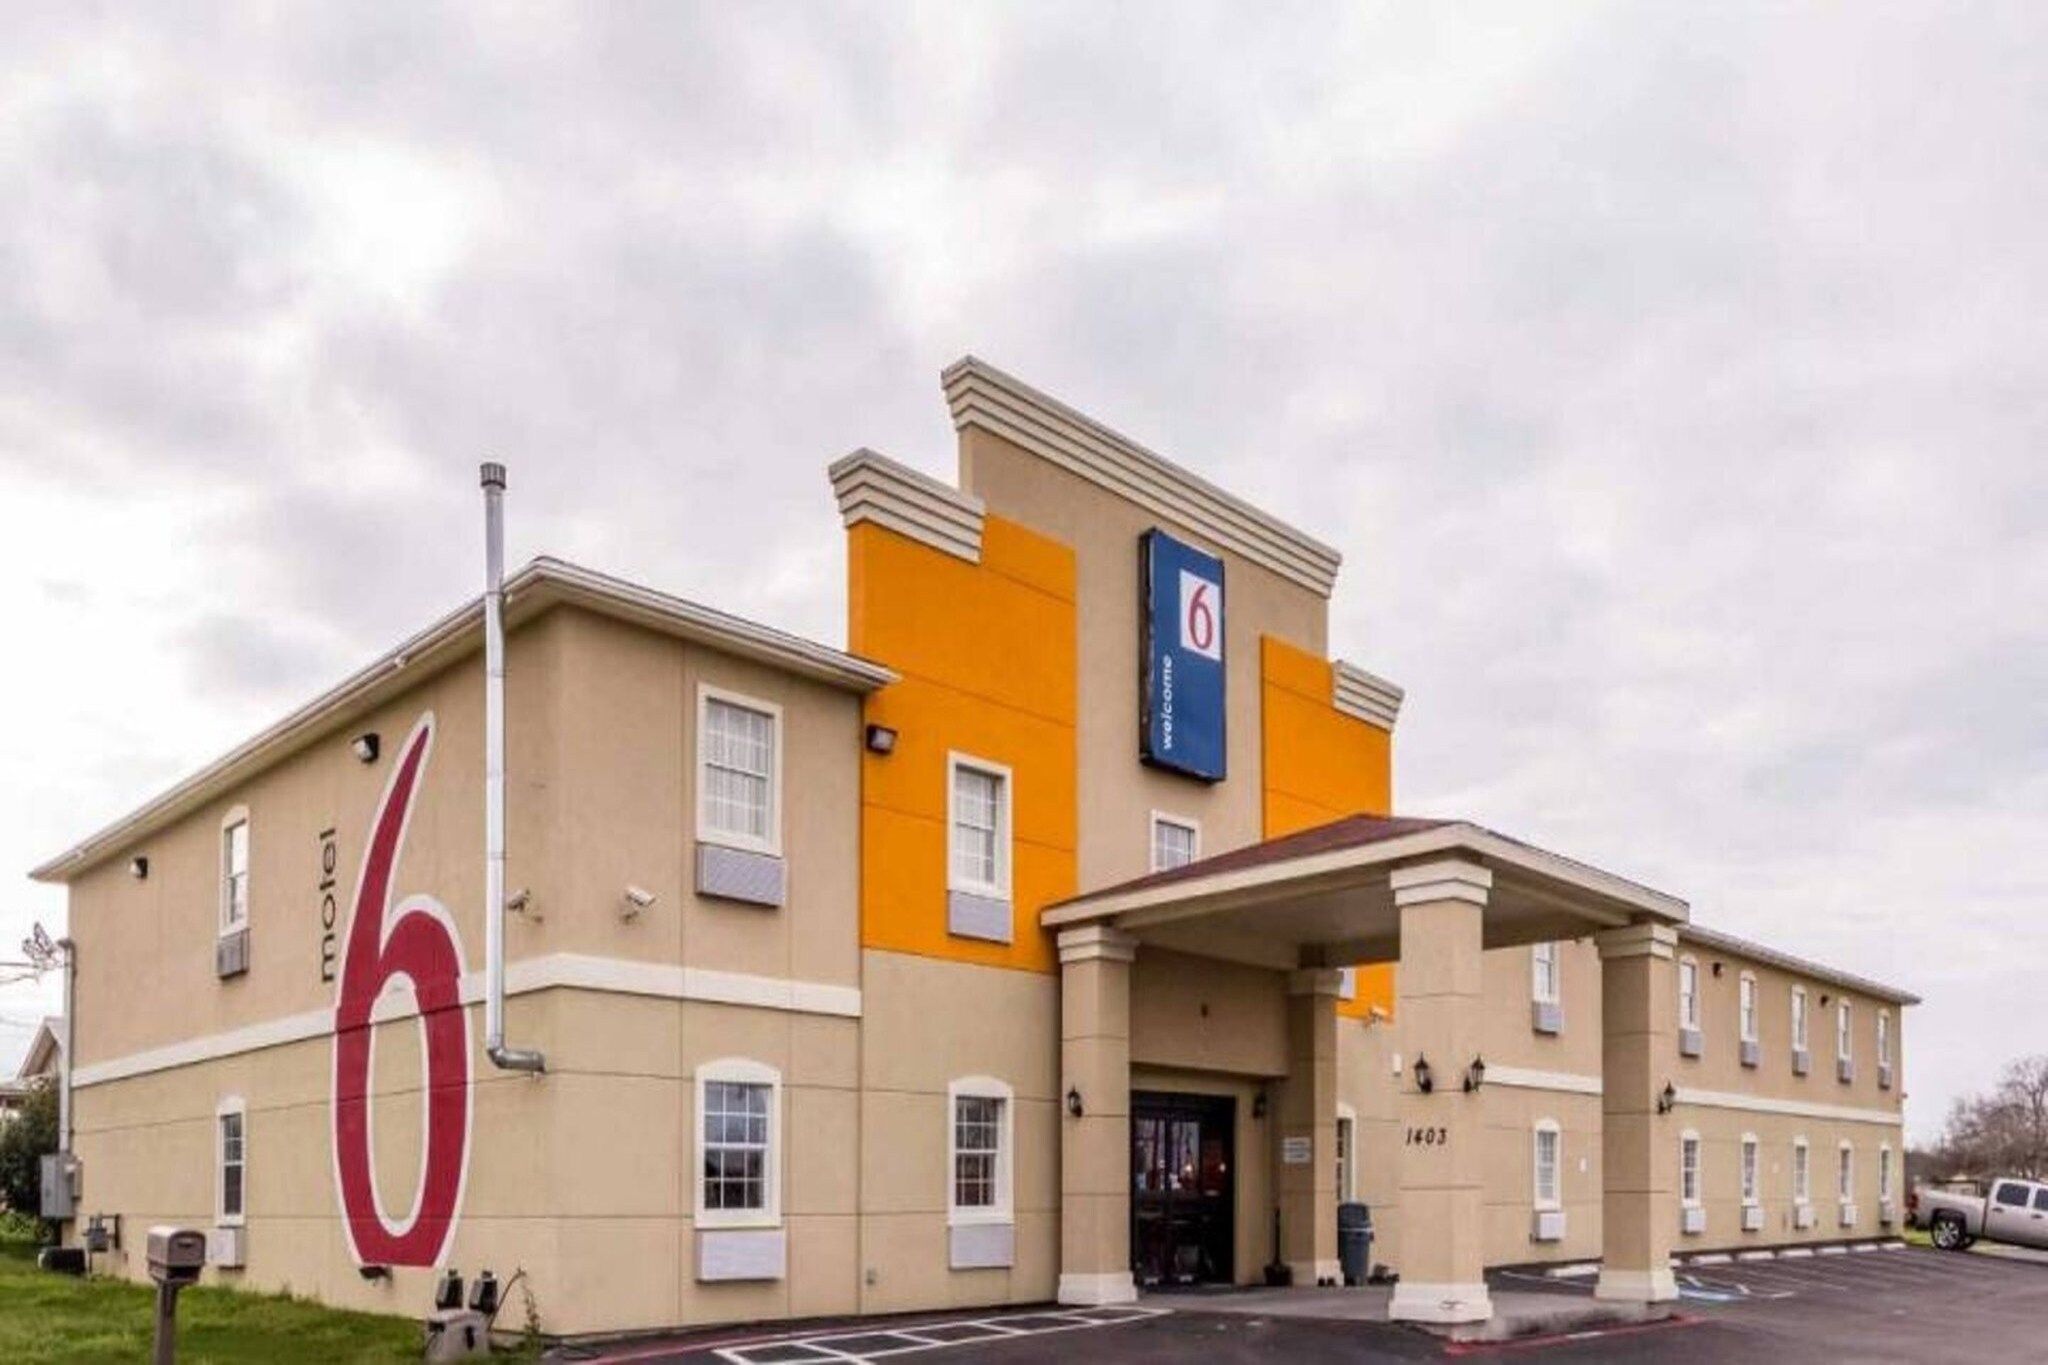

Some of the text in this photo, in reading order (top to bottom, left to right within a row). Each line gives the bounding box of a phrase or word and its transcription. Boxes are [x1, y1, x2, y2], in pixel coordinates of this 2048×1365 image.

[1188, 583, 1213, 650] 6
[1161, 654, 1173, 750] welcome
[319, 828, 337, 984] motel
[333, 716, 471, 1268] 6
[1405, 1126, 1448, 1146] 1403
